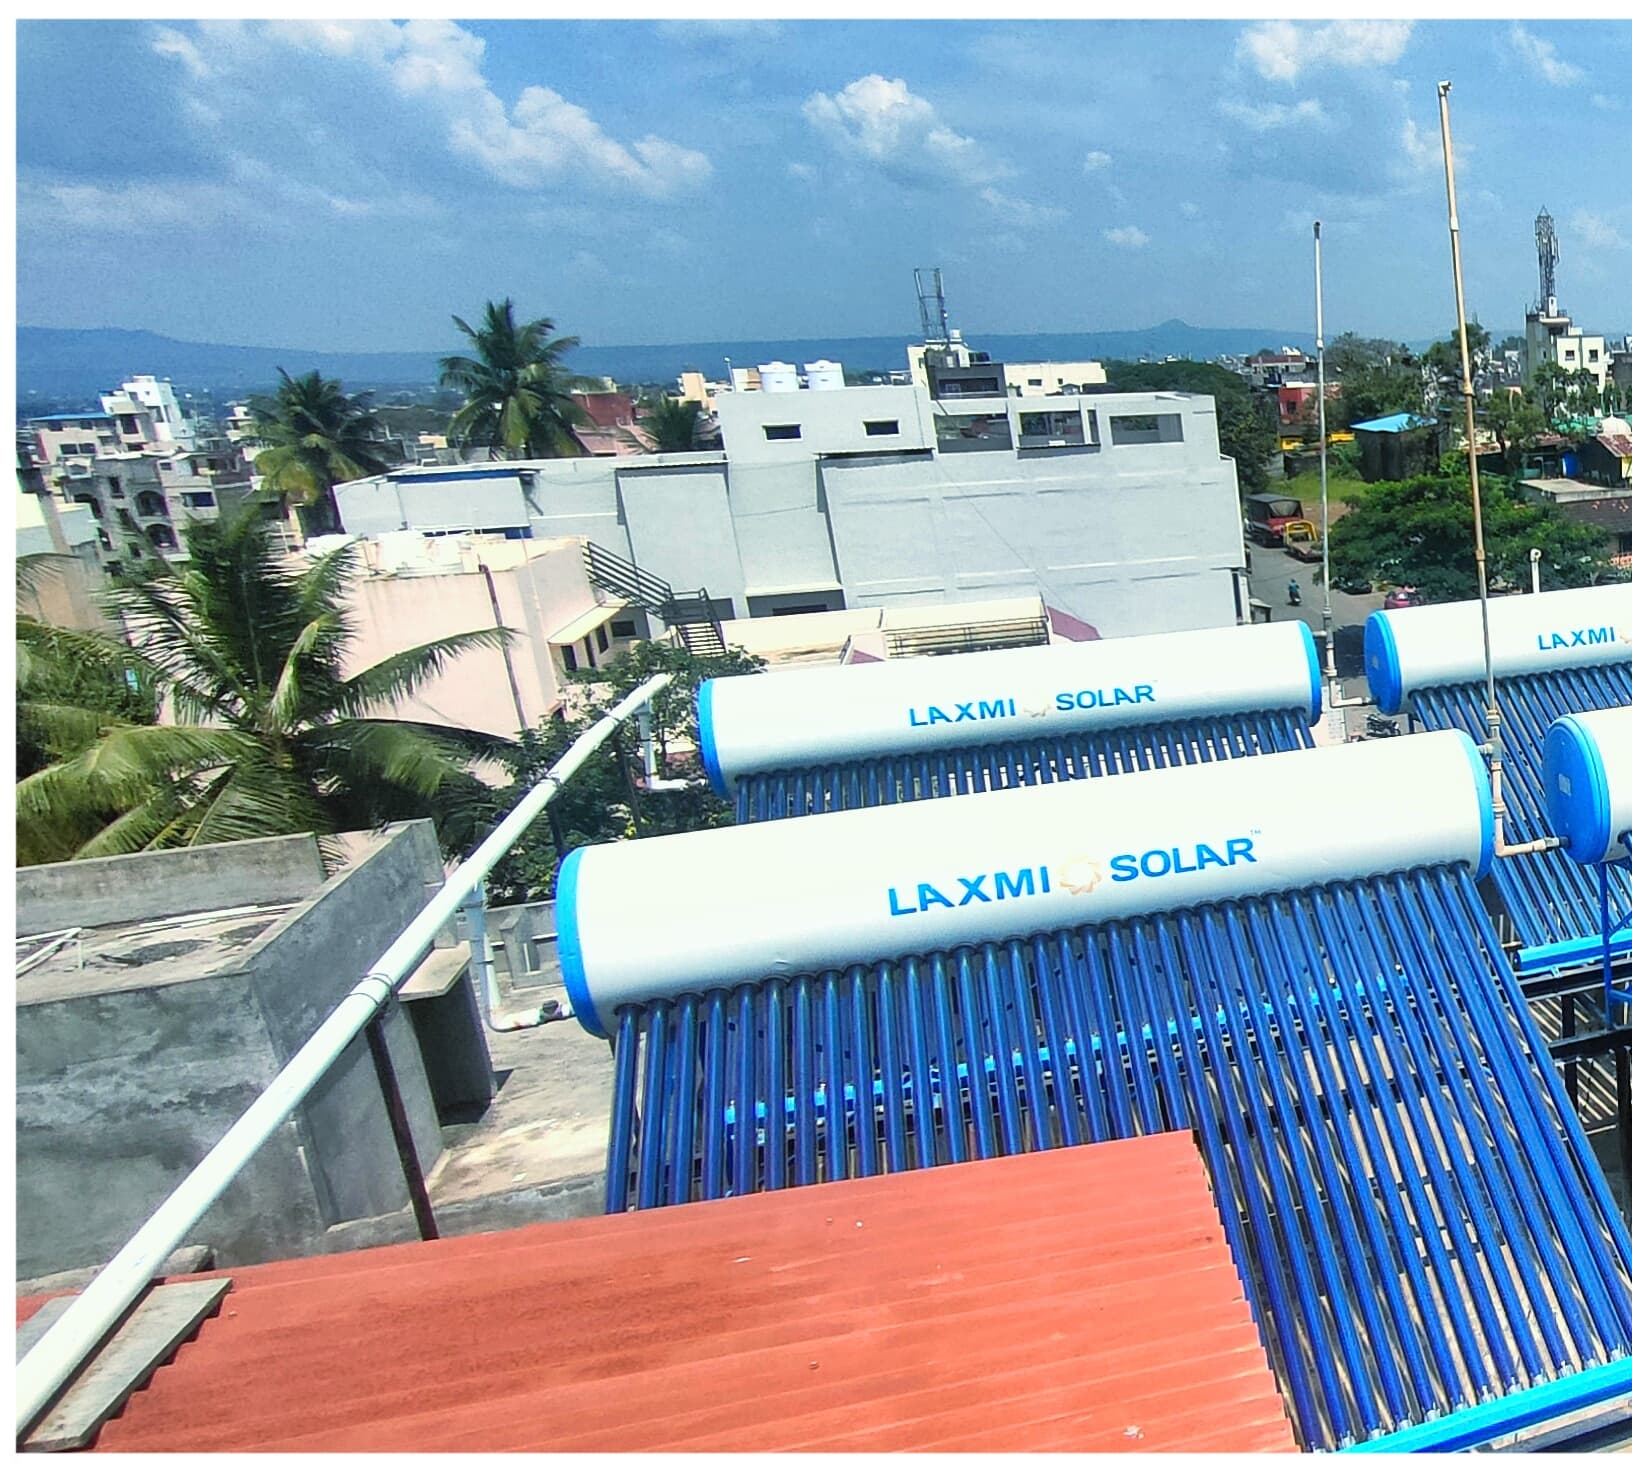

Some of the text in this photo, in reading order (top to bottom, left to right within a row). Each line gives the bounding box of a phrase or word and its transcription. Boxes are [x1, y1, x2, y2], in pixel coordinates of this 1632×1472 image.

[1537, 626, 1616, 651] LAXMI
[908, 684, 1157, 727] LAXMI SOLAR
[887, 866, 1051, 916] LAXMI
[1110, 837, 1257, 883] SOLAR
